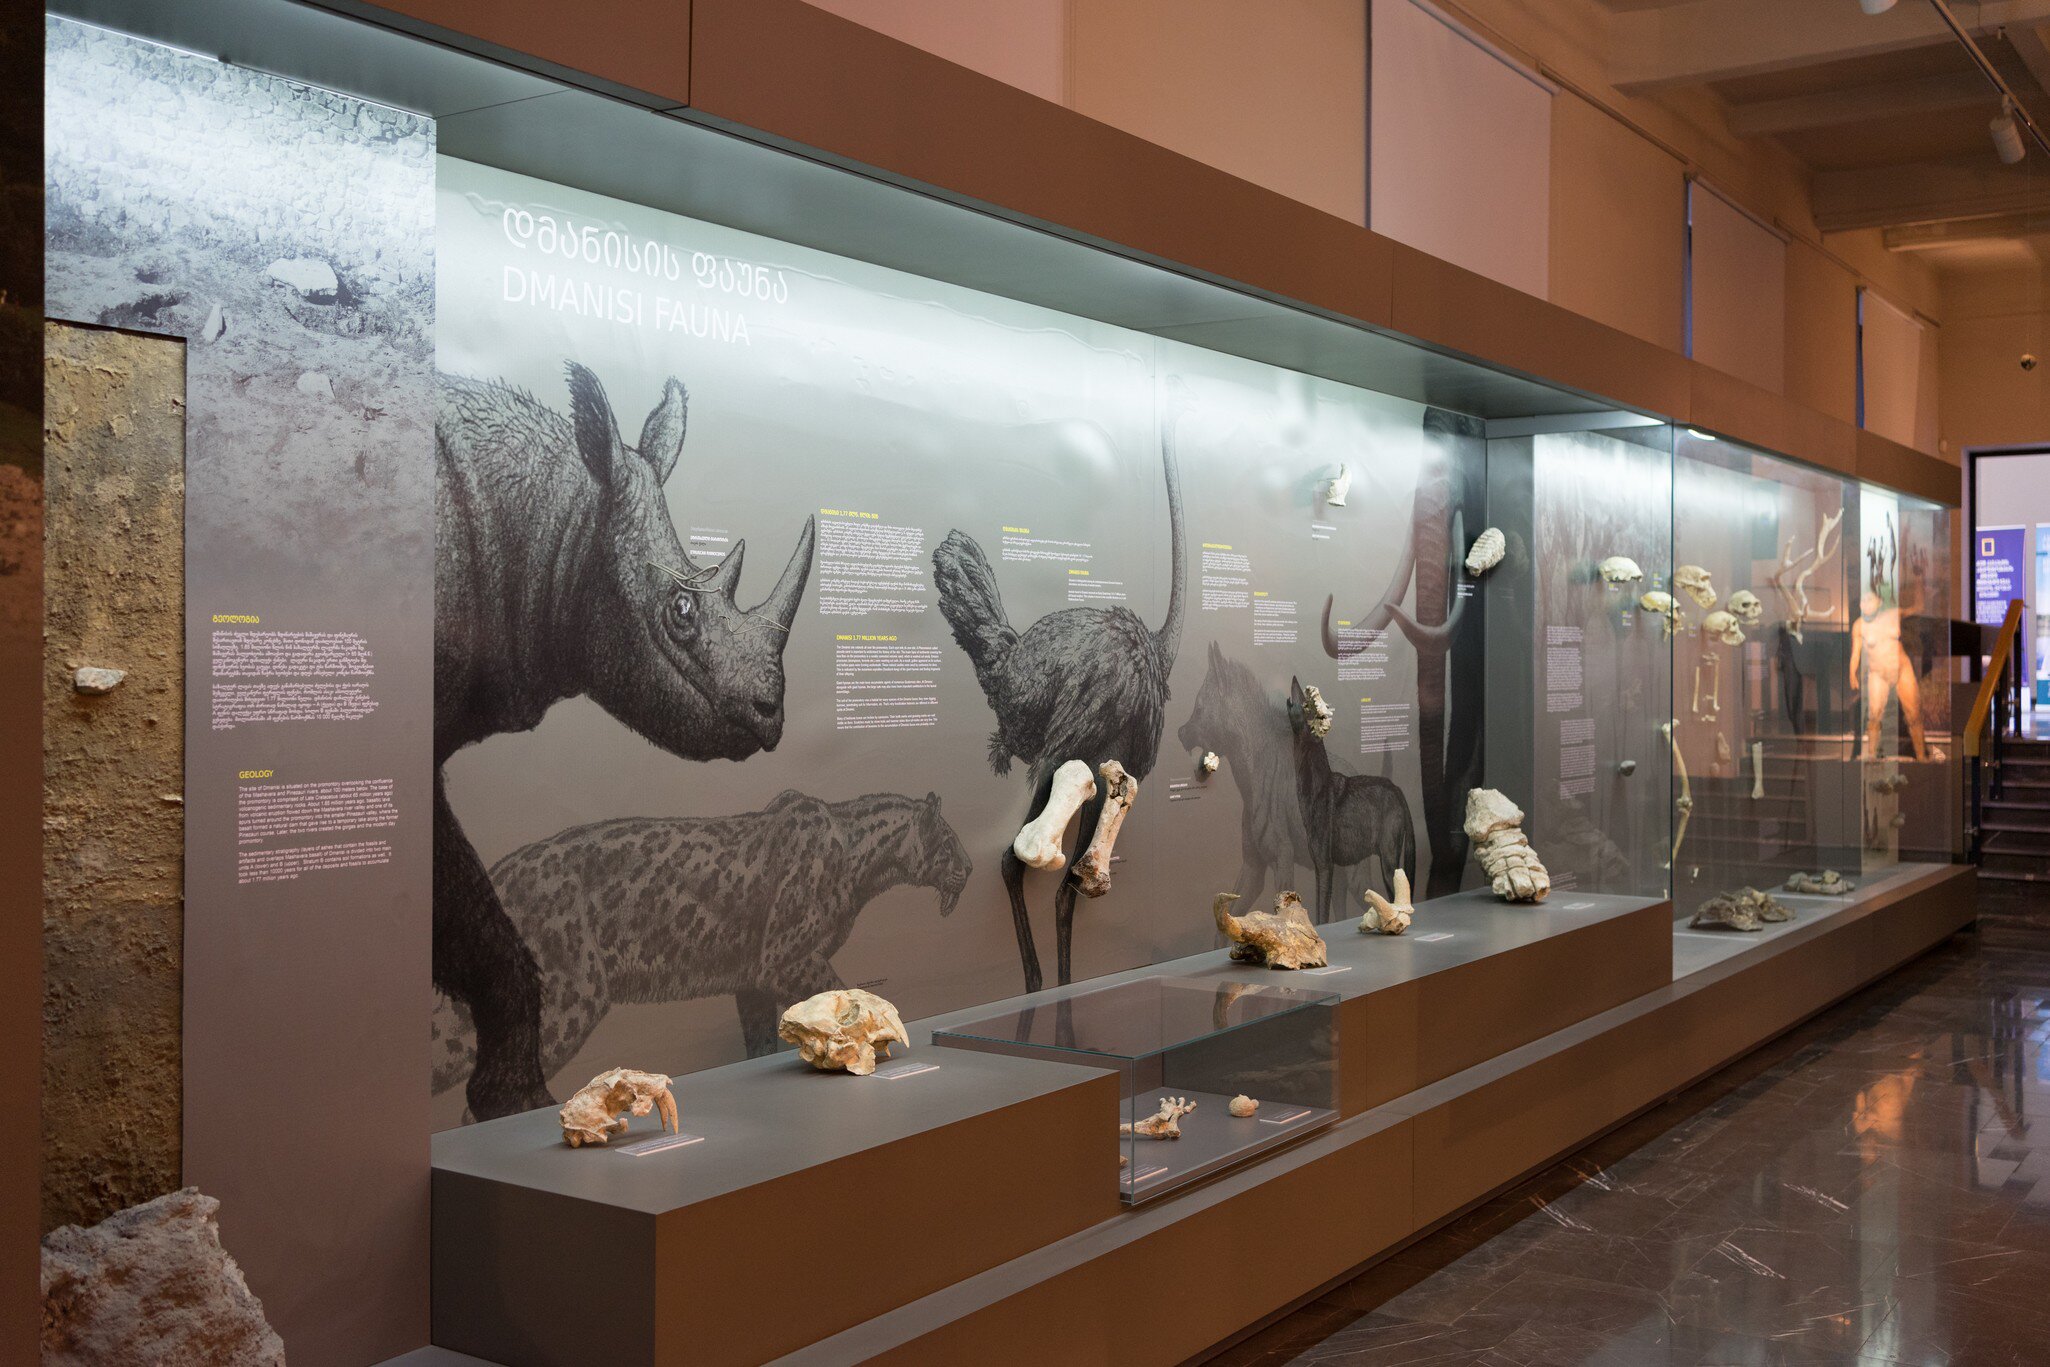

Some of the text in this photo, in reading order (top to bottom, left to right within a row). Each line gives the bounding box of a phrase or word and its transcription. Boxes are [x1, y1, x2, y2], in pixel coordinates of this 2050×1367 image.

[503, 208, 788, 304] დმანისის ფაუნა
[503, 265, 751, 346] DMANISI FAUNA
[239, 770, 273, 778] GEOLOGY
